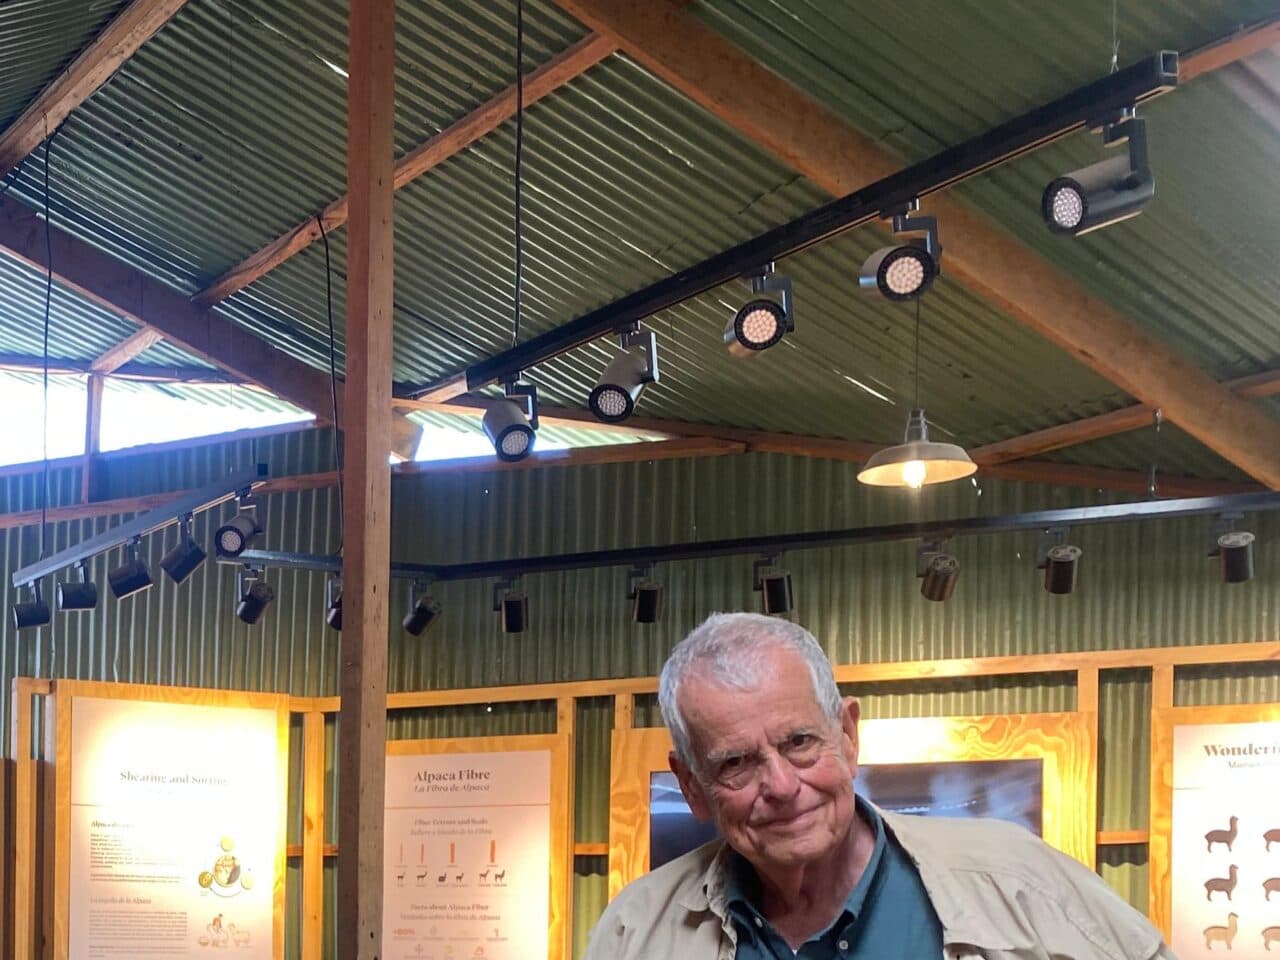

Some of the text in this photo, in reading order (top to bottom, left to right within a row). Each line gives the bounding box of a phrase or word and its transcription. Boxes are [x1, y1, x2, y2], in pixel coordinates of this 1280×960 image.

[1203, 743, 1280, 757] Wonderi
[120, 770, 167, 785] Shearing
[169, 773, 189, 785] and
[414, 769, 491, 783] Alpaca Fibre
[426, 784, 448, 793] Fibra
[450, 784, 460, 792] de
[461, 784, 490, 793] Alpaca
